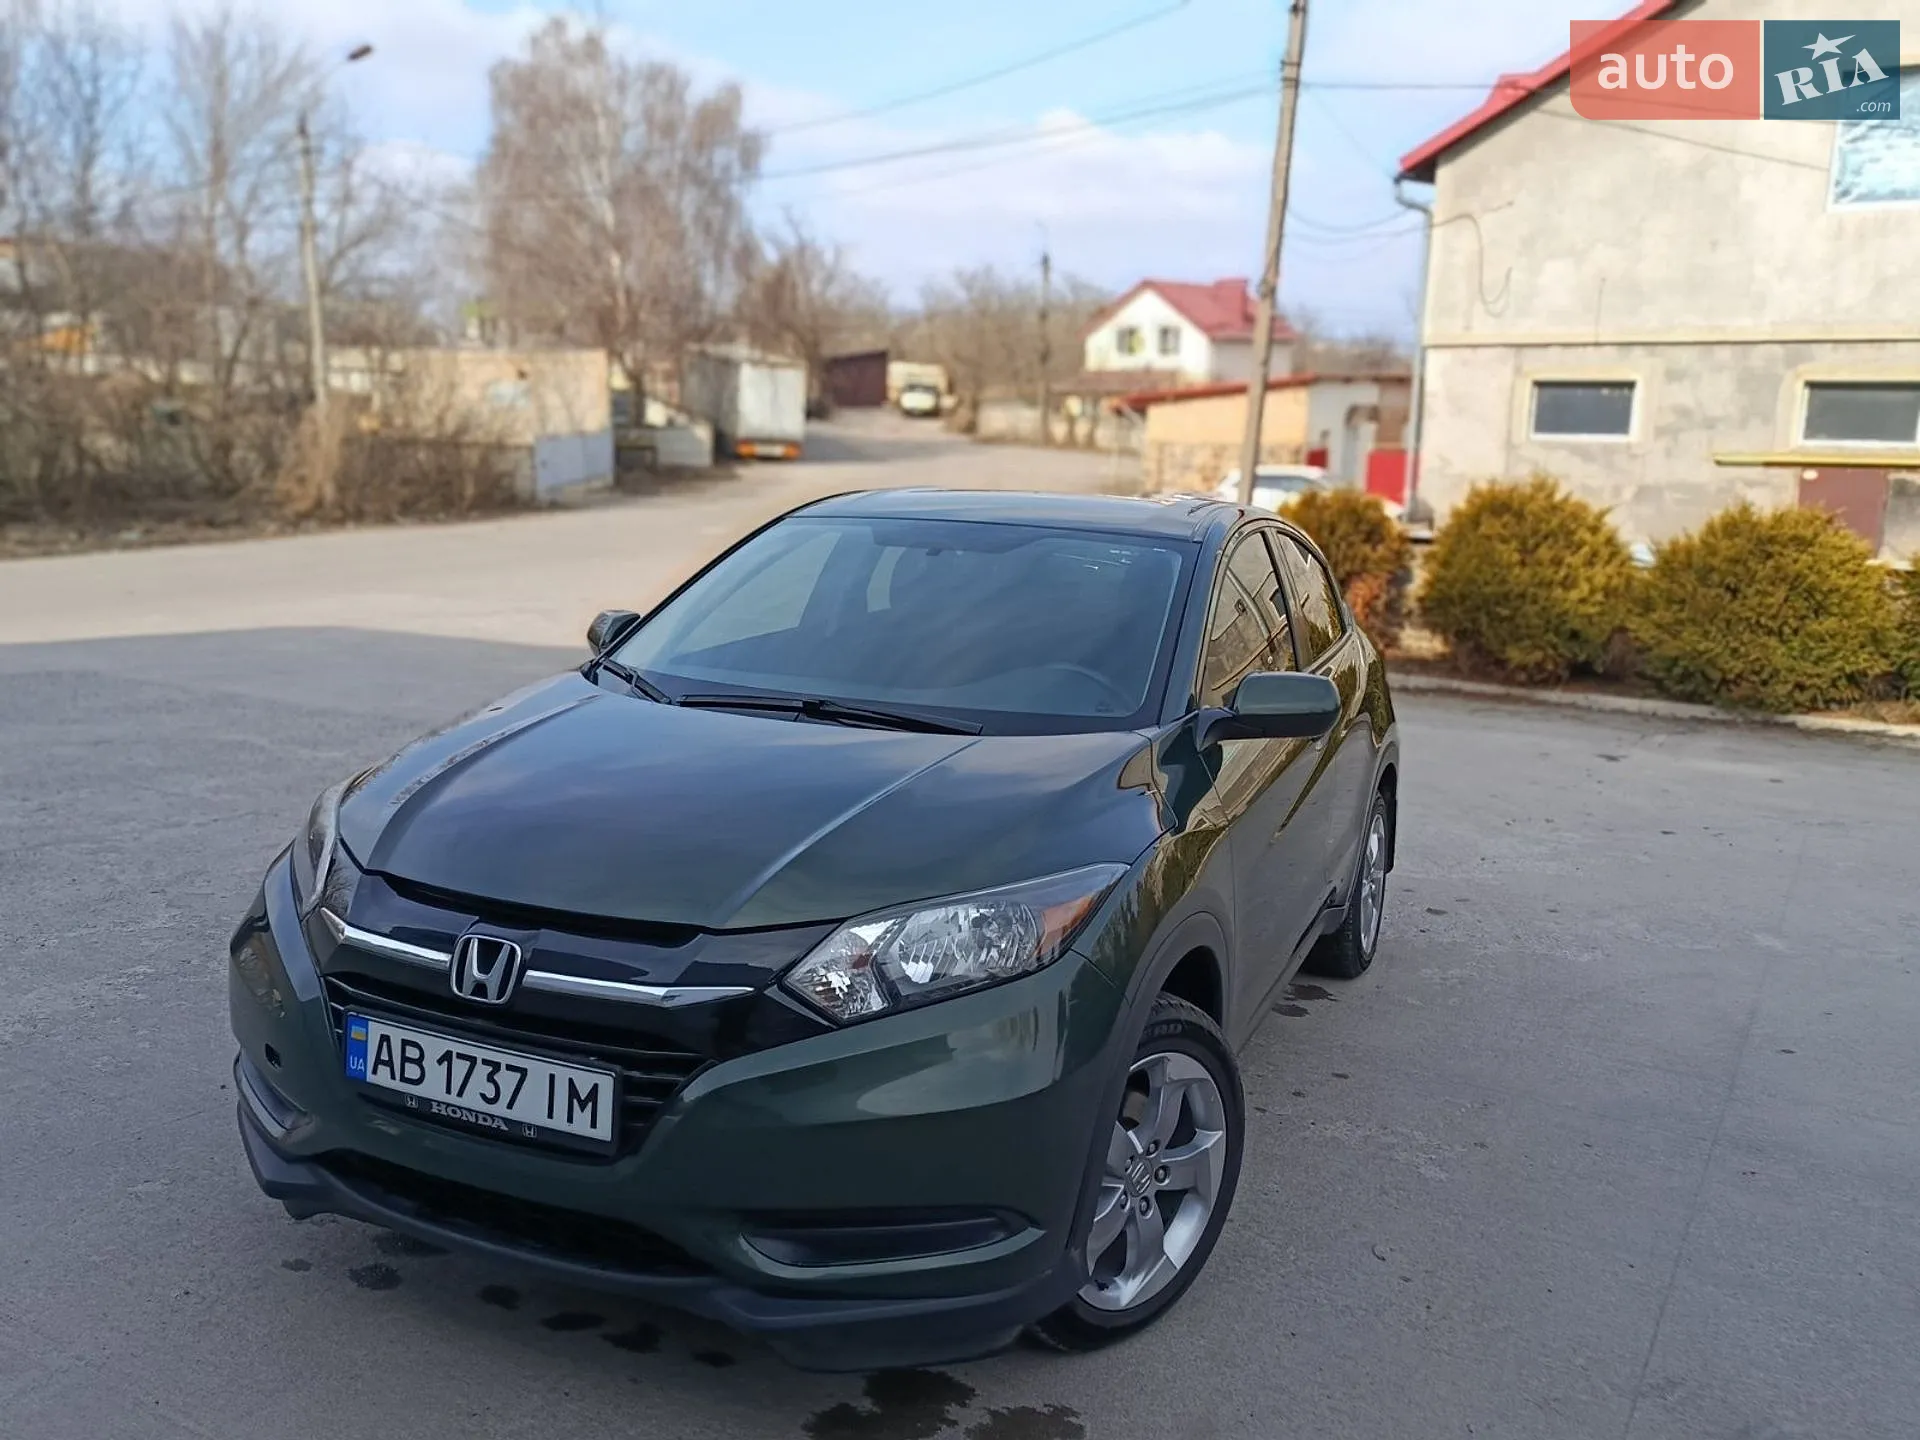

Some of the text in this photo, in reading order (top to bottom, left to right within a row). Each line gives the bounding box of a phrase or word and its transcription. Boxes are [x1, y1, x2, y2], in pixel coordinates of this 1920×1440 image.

[350, 1056, 365, 1073] UA
[371, 1033, 599, 1130] AB 1737 IM
[429, 1101, 510, 1132] HONDA
